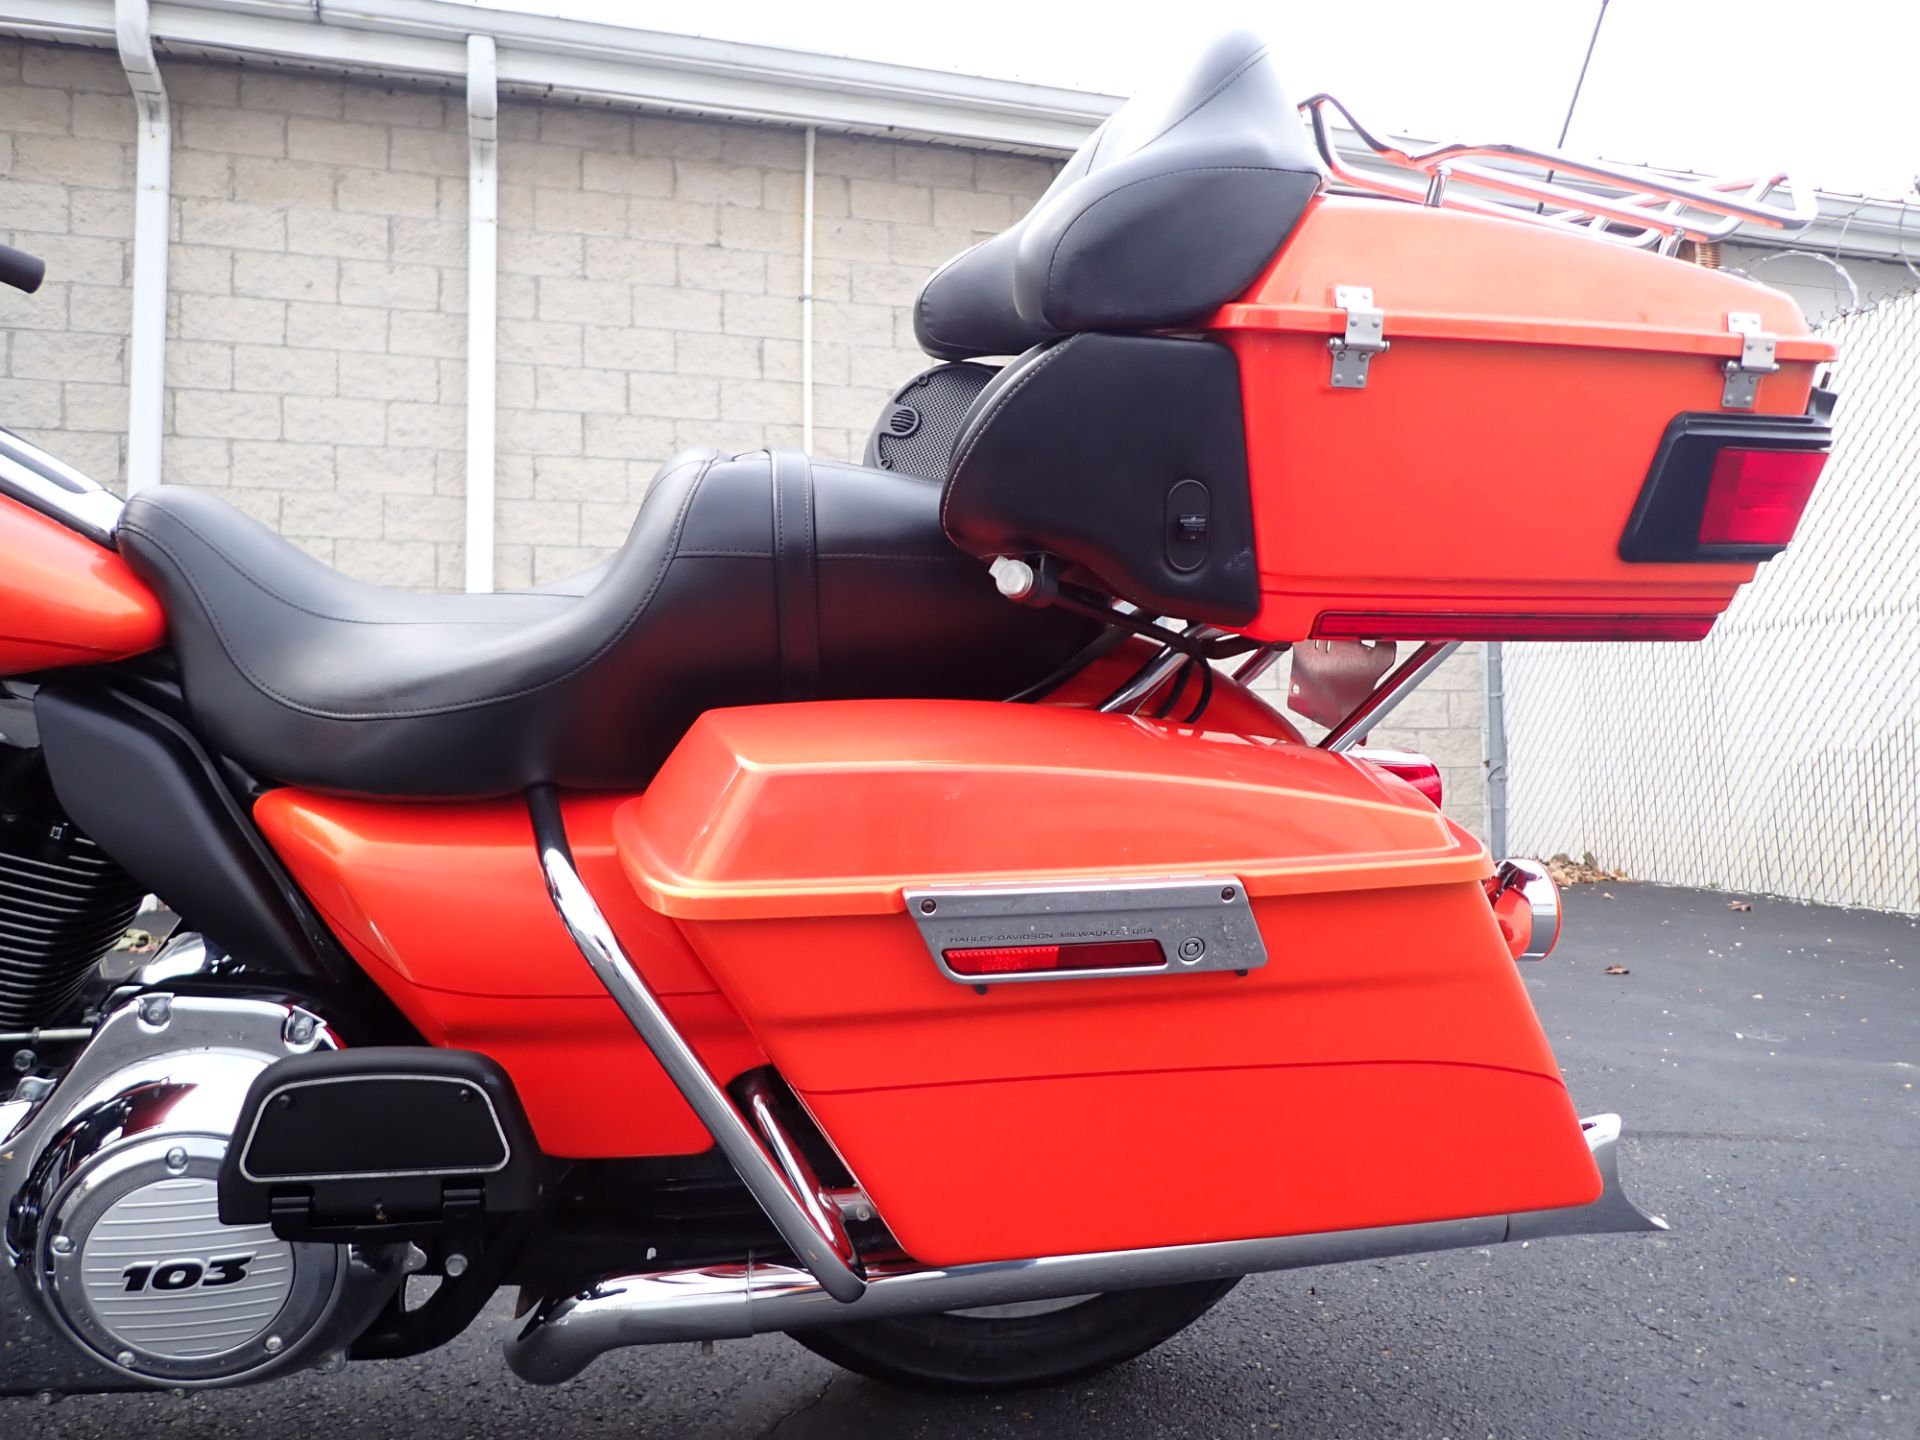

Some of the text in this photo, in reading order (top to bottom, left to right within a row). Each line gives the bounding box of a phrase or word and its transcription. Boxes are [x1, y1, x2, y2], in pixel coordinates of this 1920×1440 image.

[950, 932, 1053, 943] HARLEY-DAVIDSON
[1132, 927, 1154, 935] USA
[122, 1251, 256, 1292] 103
